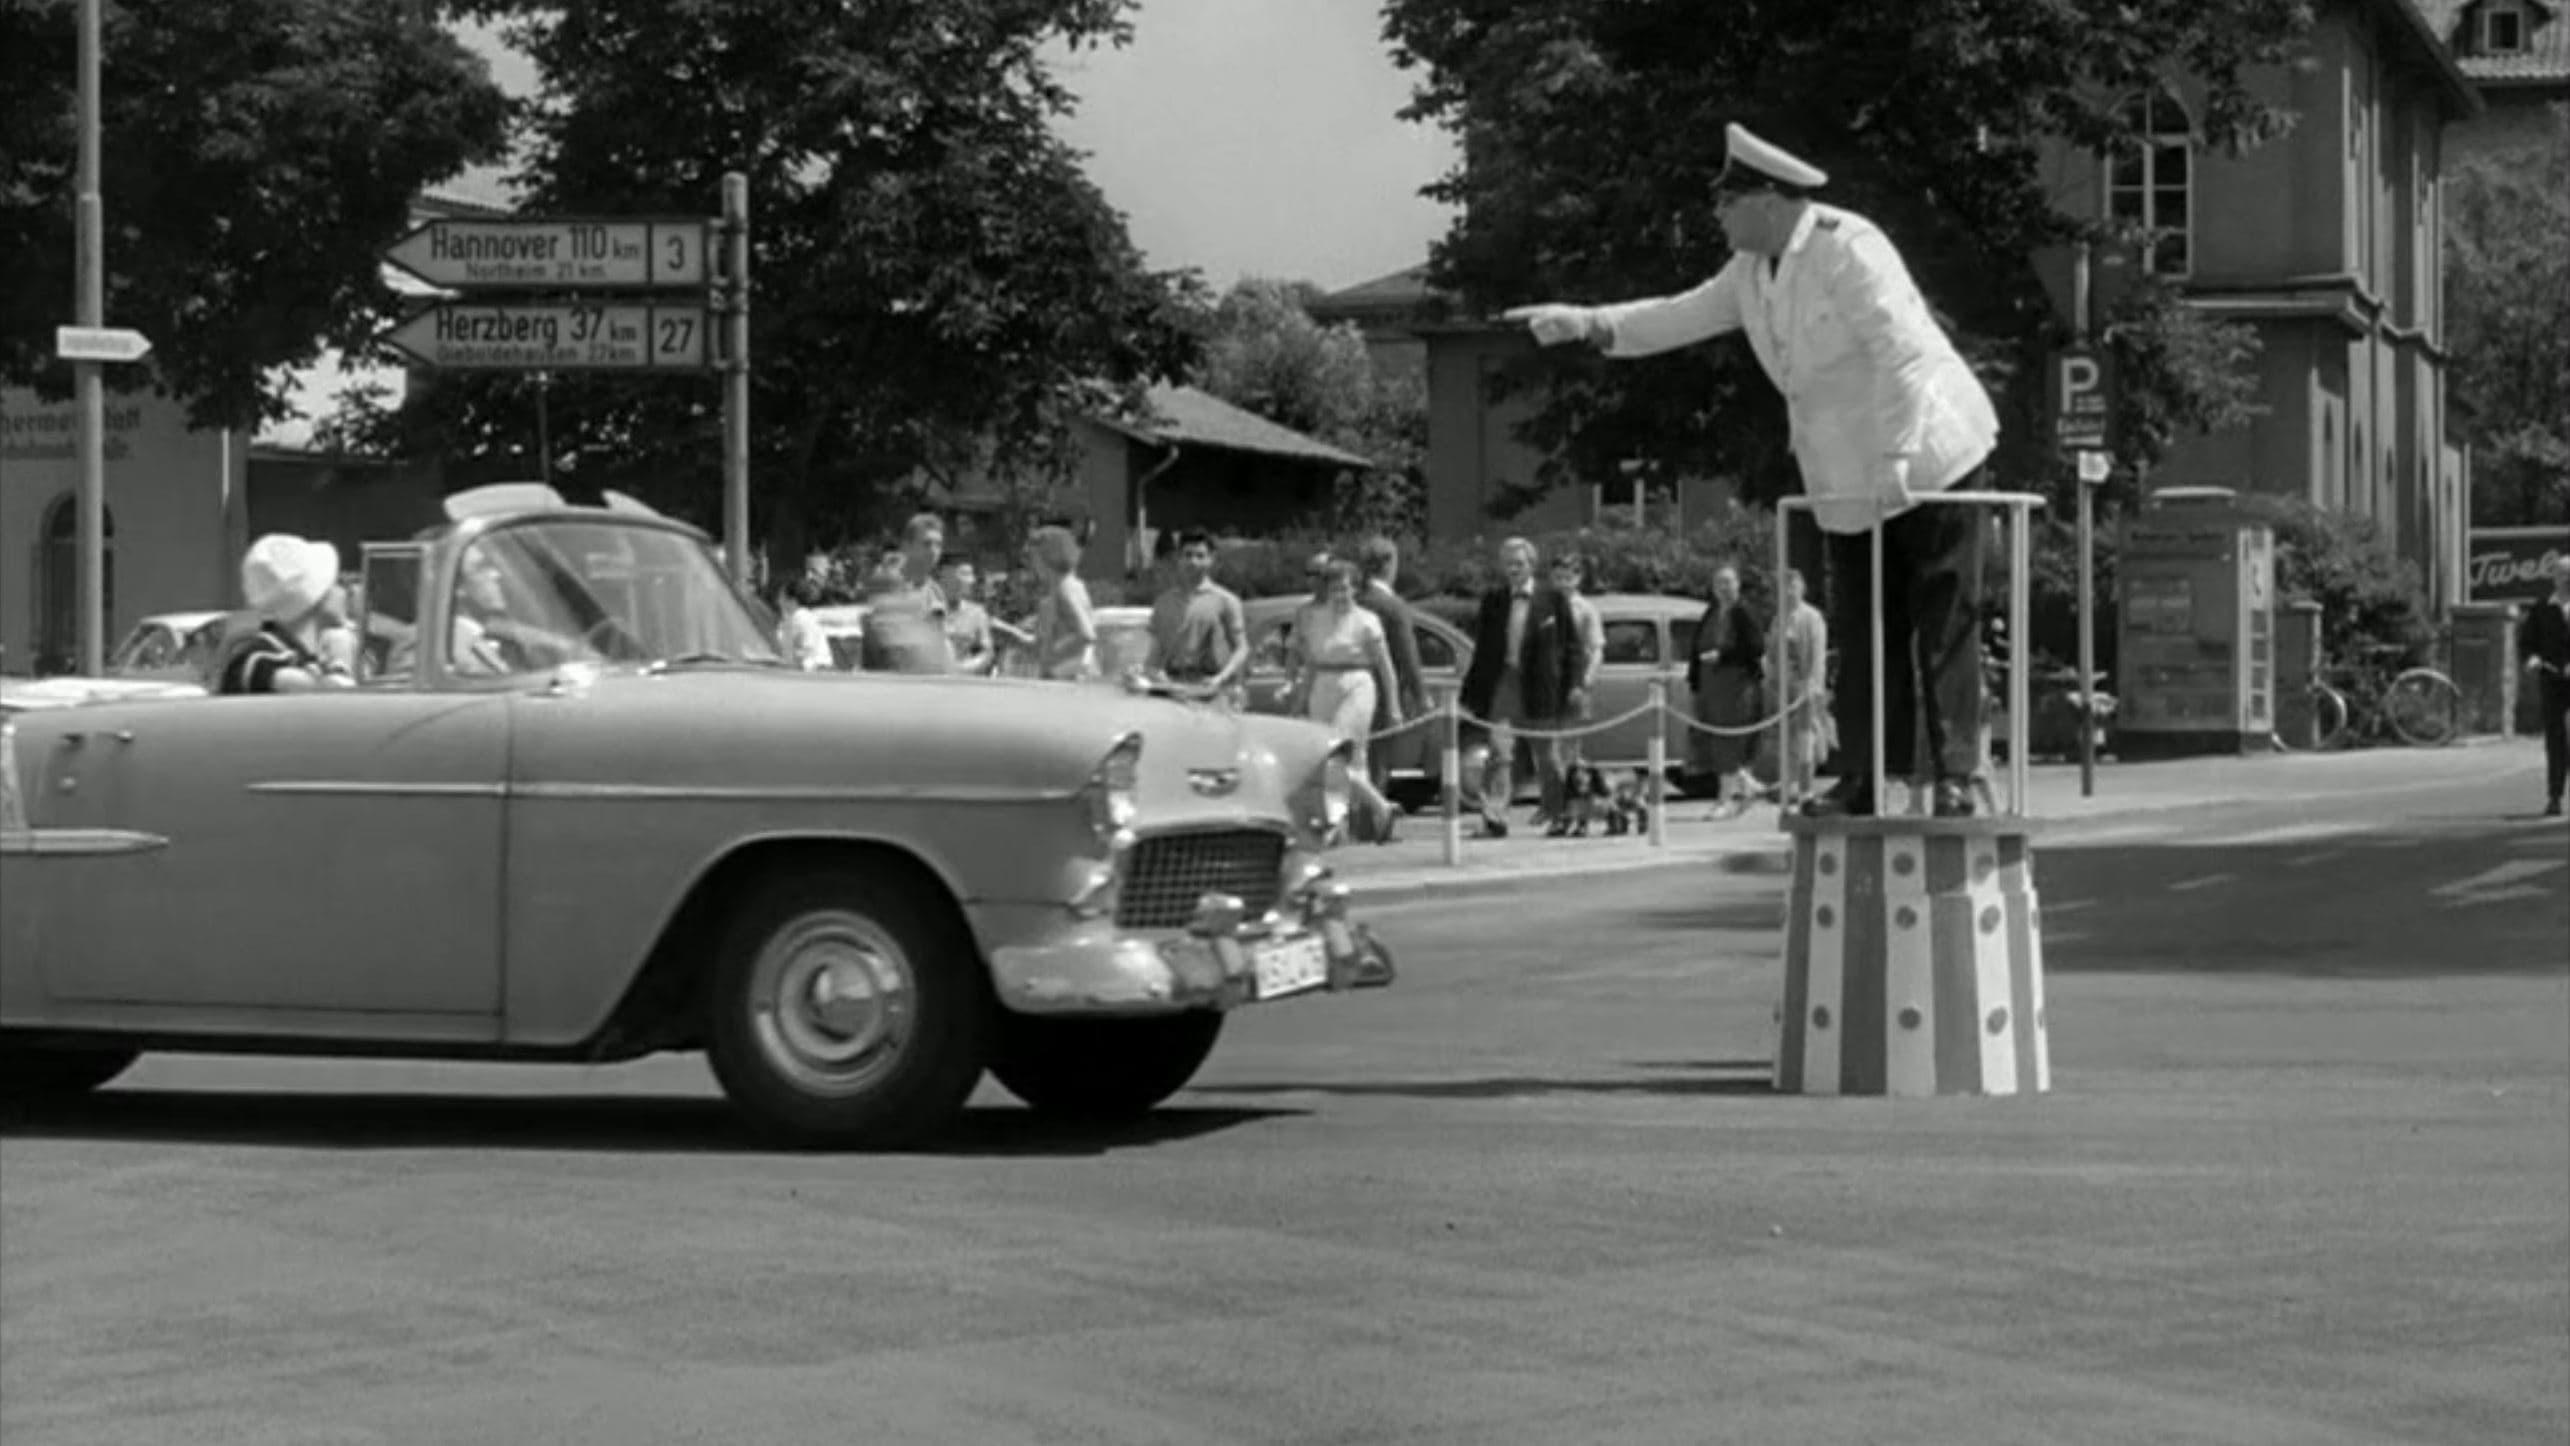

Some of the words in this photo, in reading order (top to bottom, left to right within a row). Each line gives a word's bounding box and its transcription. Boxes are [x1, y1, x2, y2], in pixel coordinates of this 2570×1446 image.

[431, 226, 559, 259] Hannover
[568, 226, 607, 259] 110
[613, 239, 640, 259] km
[667, 236, 685, 271] 3
[436, 307, 558, 348] Herzberg
[570, 307, 604, 341] 37
[609, 321, 637, 341] km
[659, 320, 695, 355] 27
[2061, 357, 2100, 414] P
